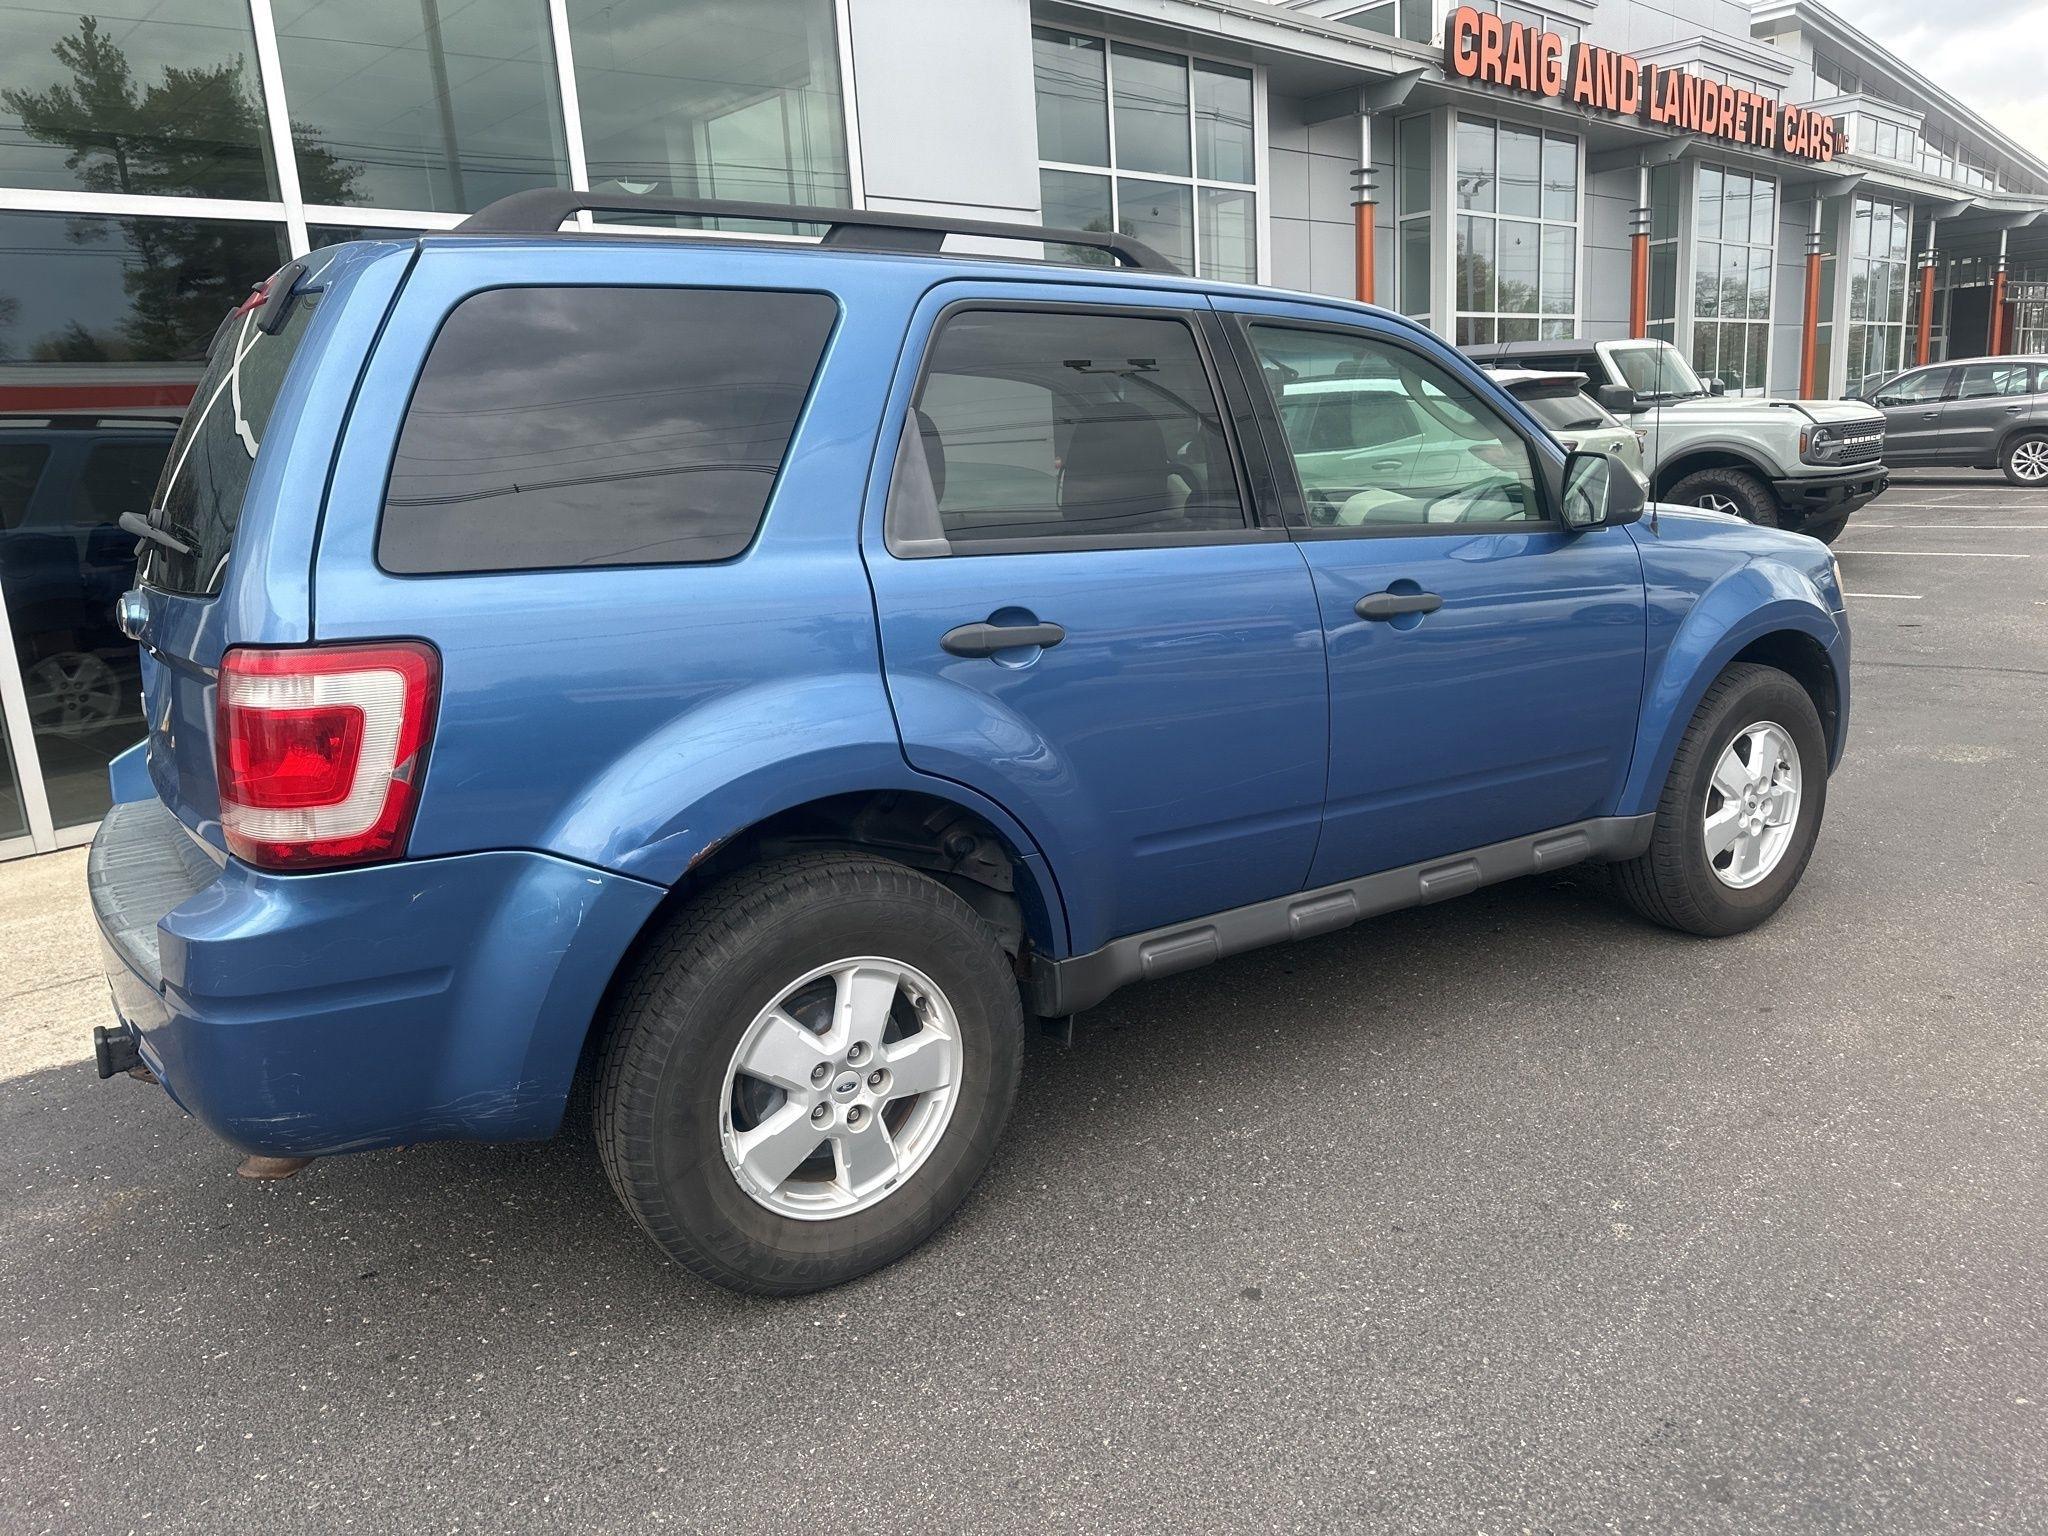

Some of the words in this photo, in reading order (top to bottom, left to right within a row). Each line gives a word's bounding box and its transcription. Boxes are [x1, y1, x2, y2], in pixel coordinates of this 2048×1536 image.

[1453, 6, 1562, 97] CRAIG
[1573, 42, 1639, 115] AND
[1650, 64, 1776, 149] LANDRETH
[1784, 104, 1833, 162] CARS
[1843, 434, 1881, 445] BRONCO
